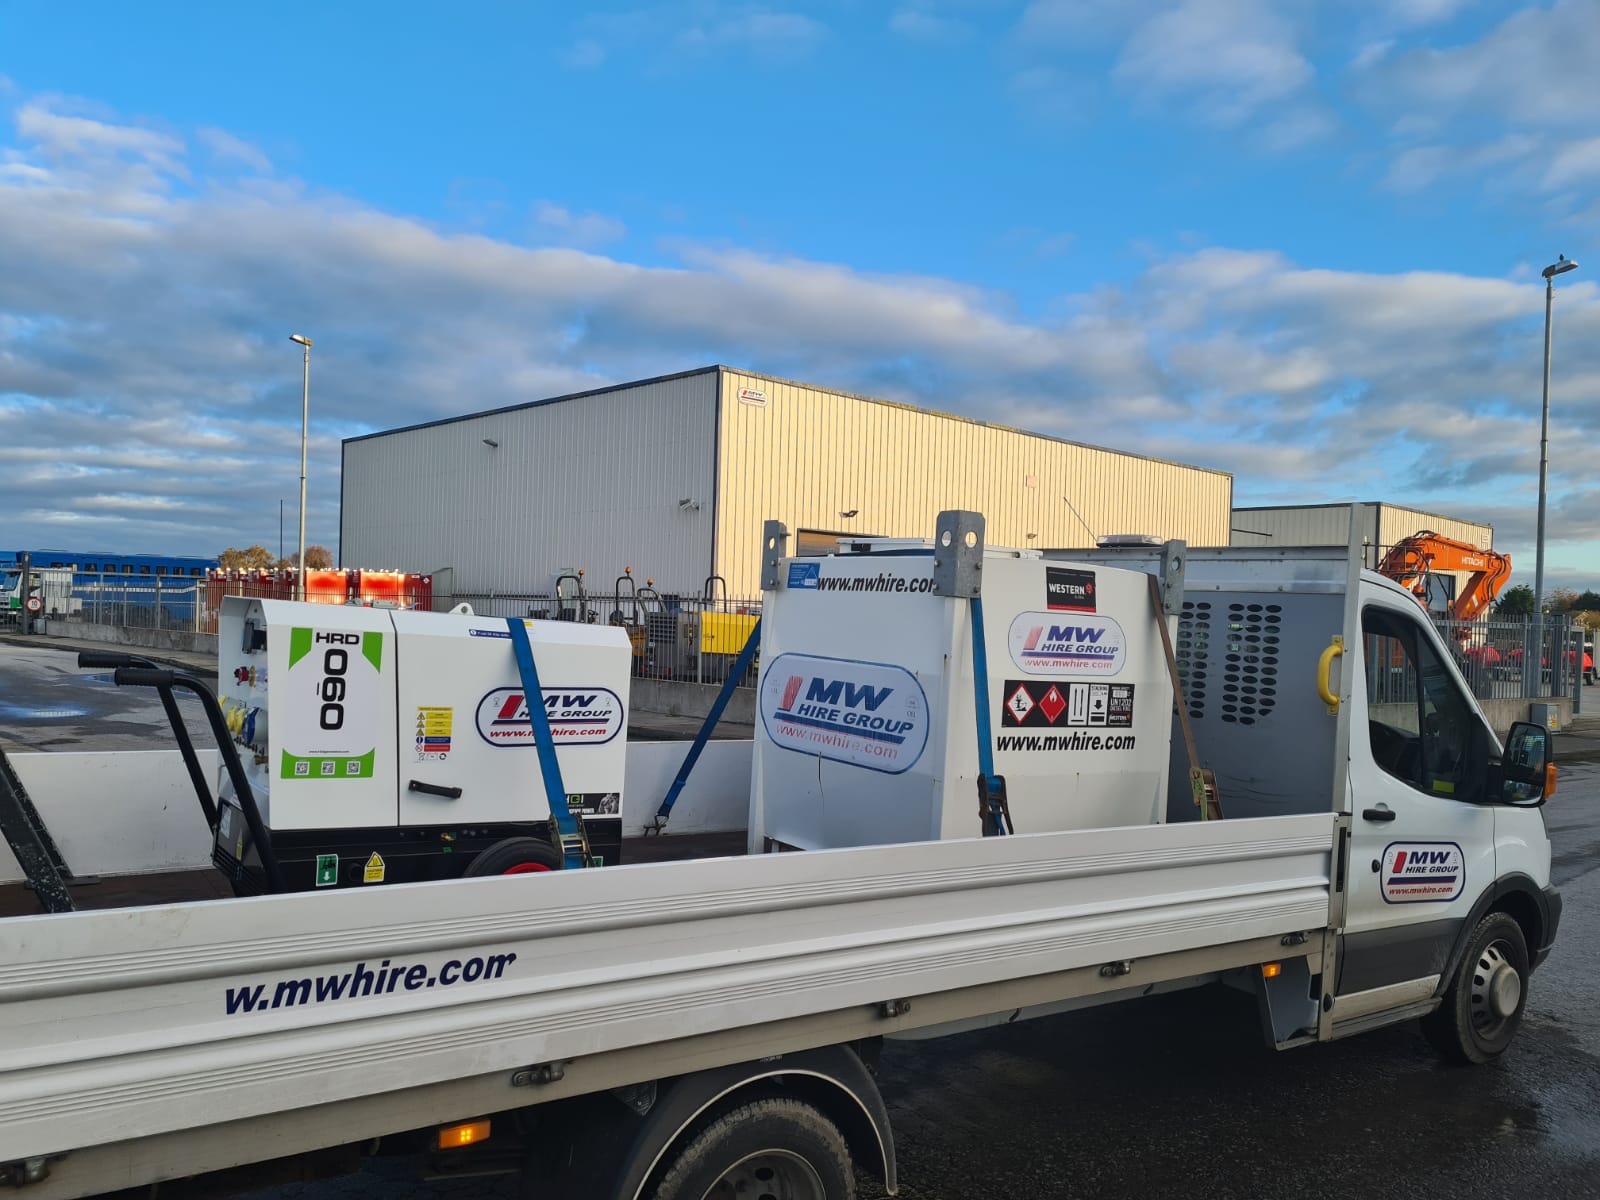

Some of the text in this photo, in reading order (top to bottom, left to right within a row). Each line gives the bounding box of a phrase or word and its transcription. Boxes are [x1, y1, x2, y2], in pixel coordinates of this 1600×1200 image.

[1048, 583, 1085, 594] WESTERN
[315, 632, 360, 645] HRD
[1047, 626, 1106, 643] MW
[1041, 644, 1119, 654] HIRE GROUP
[1024, 660, 1113, 669] www.mwhire.com
[805, 677, 895, 711] MW
[560, 710, 612, 718] GROUP
[797, 703, 914, 734] HIRE GROUP
[776, 726, 898, 760] www.mwhire.com
[997, 731, 1136, 751] www.mwhire.com
[1409, 851, 1451, 864] MW
[1389, 886, 1453, 895] www.mwhire.com
